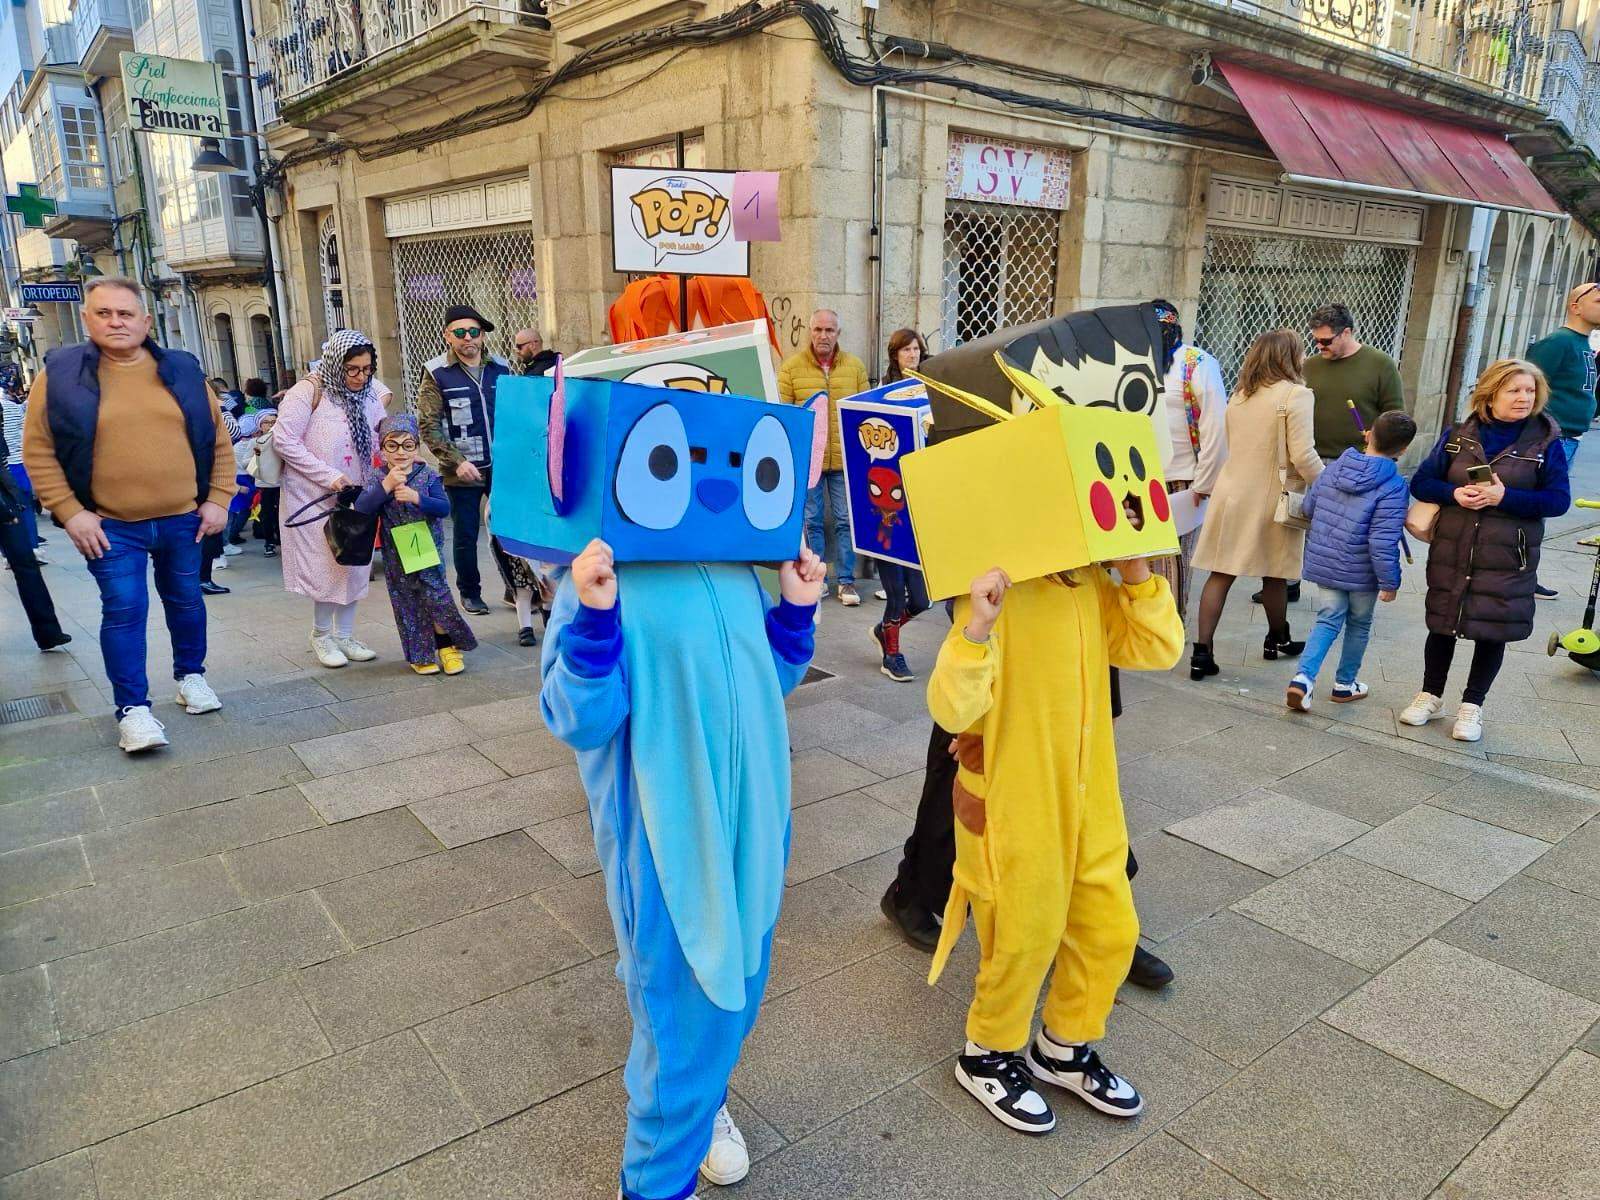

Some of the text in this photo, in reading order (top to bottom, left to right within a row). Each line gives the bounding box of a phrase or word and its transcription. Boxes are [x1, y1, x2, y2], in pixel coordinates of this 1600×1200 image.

[126, 56, 167, 79] Piel
[134, 78, 222, 109] Confecciones
[131, 97, 221, 133] Tamara
[630, 188, 729, 239] POP!
[743, 191, 760, 219] 1
[23, 286, 80, 300] ORTOPEDIA
[858, 422, 897, 452] POP!
[410, 532, 421, 558] 1
